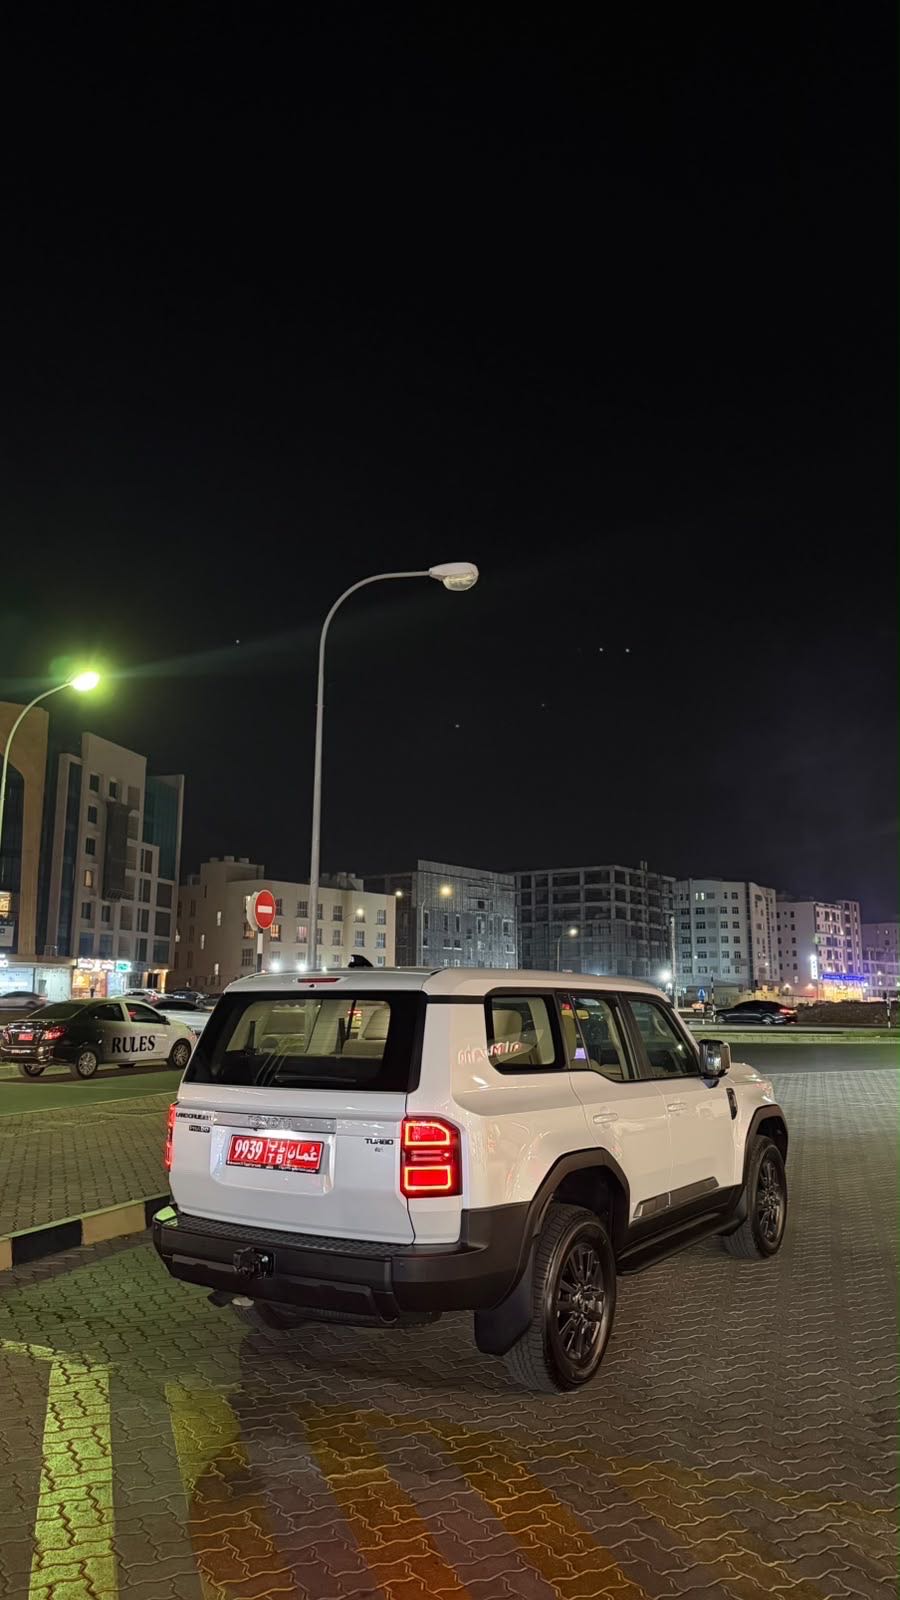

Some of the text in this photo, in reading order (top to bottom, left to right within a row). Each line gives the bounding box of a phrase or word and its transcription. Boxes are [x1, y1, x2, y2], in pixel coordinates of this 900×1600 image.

[112, 1035, 155, 1053] RULES
[234, 1139, 263, 1160] 9939
[364, 1137, 394, 1145] TURBO
